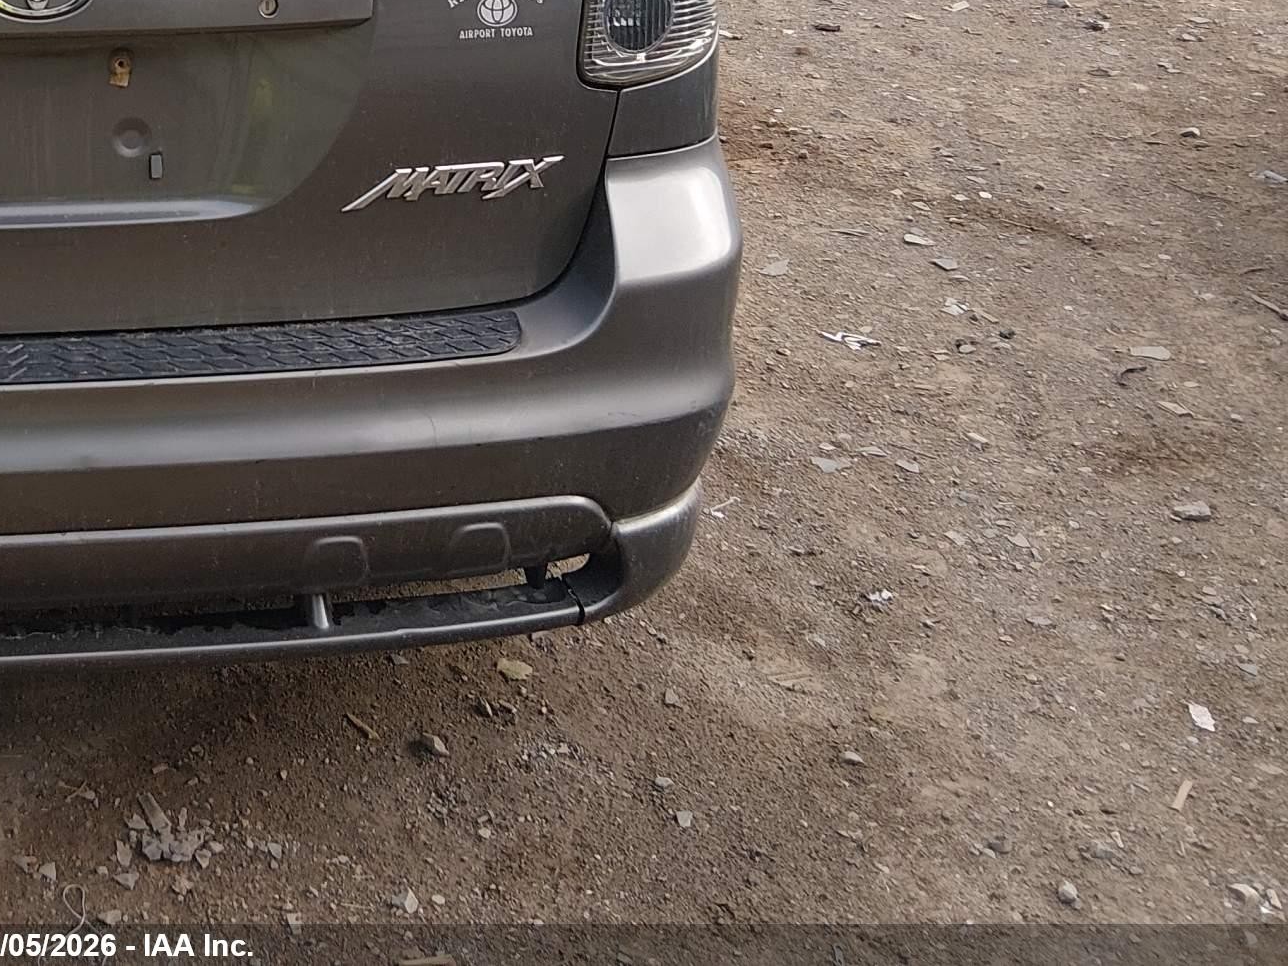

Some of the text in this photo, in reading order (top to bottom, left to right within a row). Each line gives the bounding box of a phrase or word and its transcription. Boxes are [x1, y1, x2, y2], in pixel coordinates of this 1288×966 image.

[459, 27, 533, 39] AIRPORT TOYOTA
[340, 155, 565, 213] MATRIX
